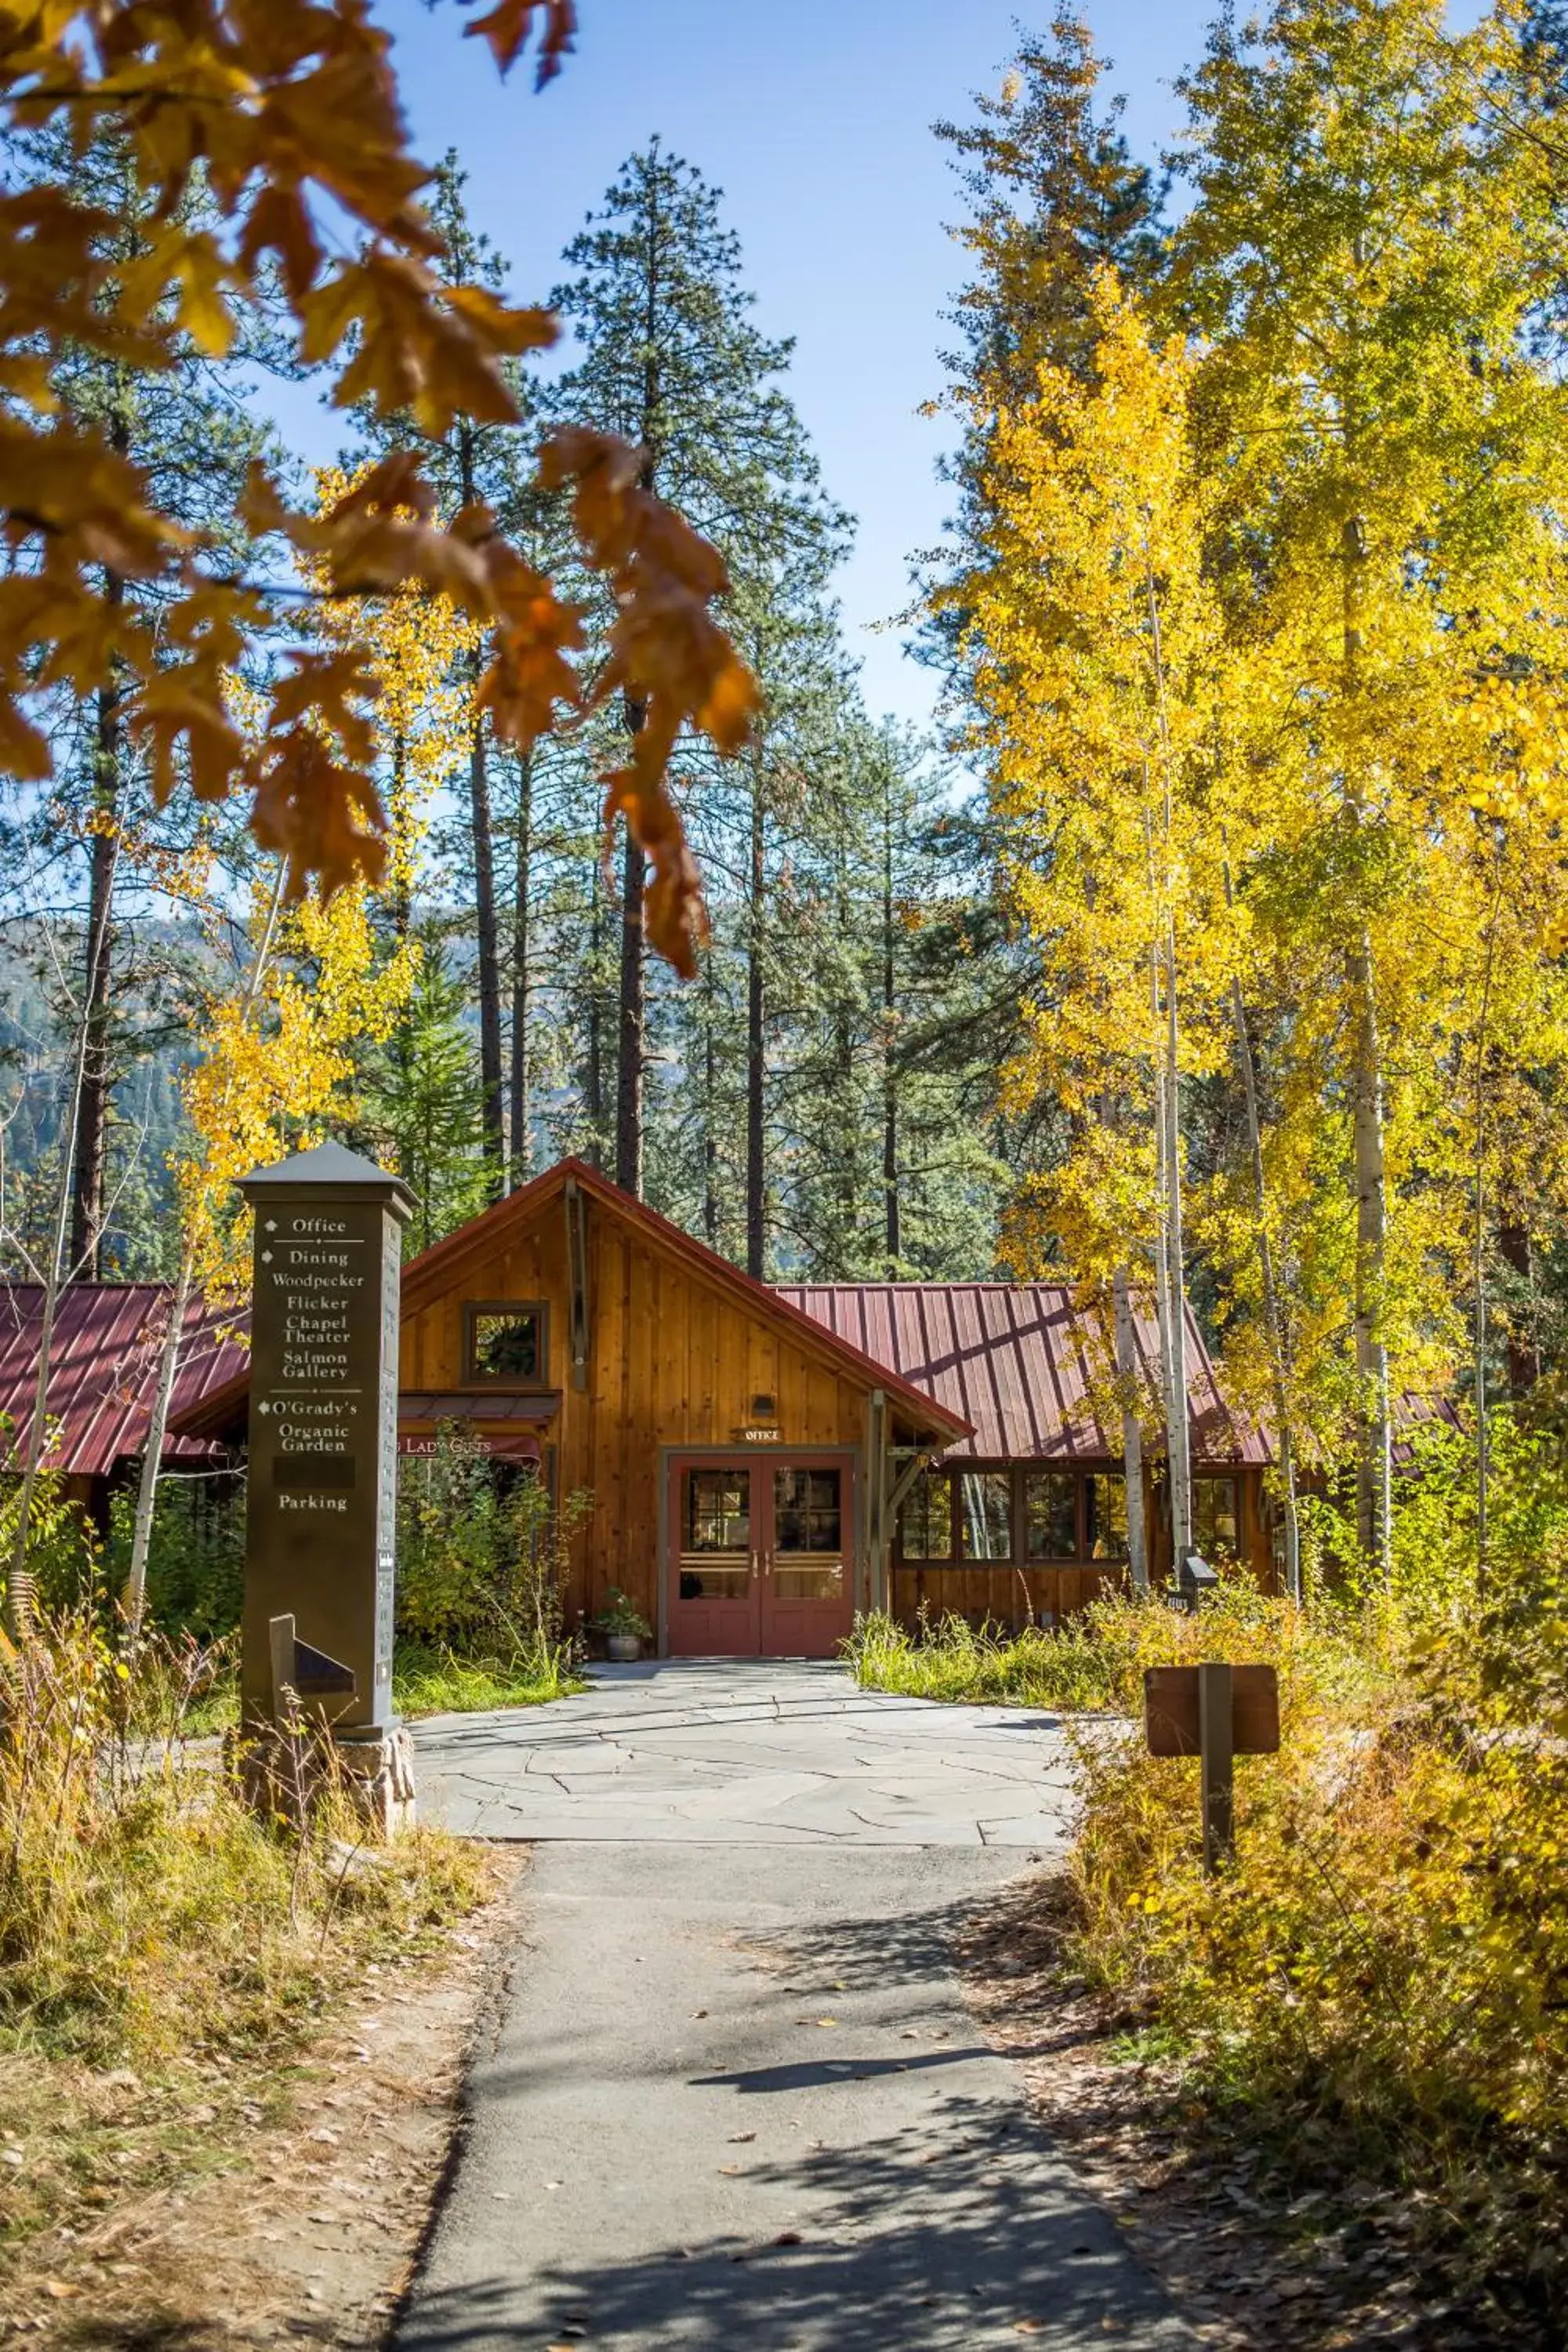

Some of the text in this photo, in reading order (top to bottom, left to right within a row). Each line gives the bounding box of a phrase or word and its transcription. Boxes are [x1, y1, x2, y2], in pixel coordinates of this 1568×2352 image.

[292, 1219, 346, 1232] Office
[290, 1250, 349, 1267] Dining
[273, 1273, 365, 1290] Woodpecker
[288, 1297, 348, 1310] Flicker
[286, 1316, 347, 1332] Chapel
[285, 1329, 350, 1343] Theater
[284, 1350, 347, 1364] Salmon
[283, 1363, 348, 1378] Gallery
[272, 1400, 357, 1416] O'Grady's
[278, 1424, 349, 1439] Organic
[281, 1436, 345, 1451] Garden
[279, 1495, 347, 1512] Parking
